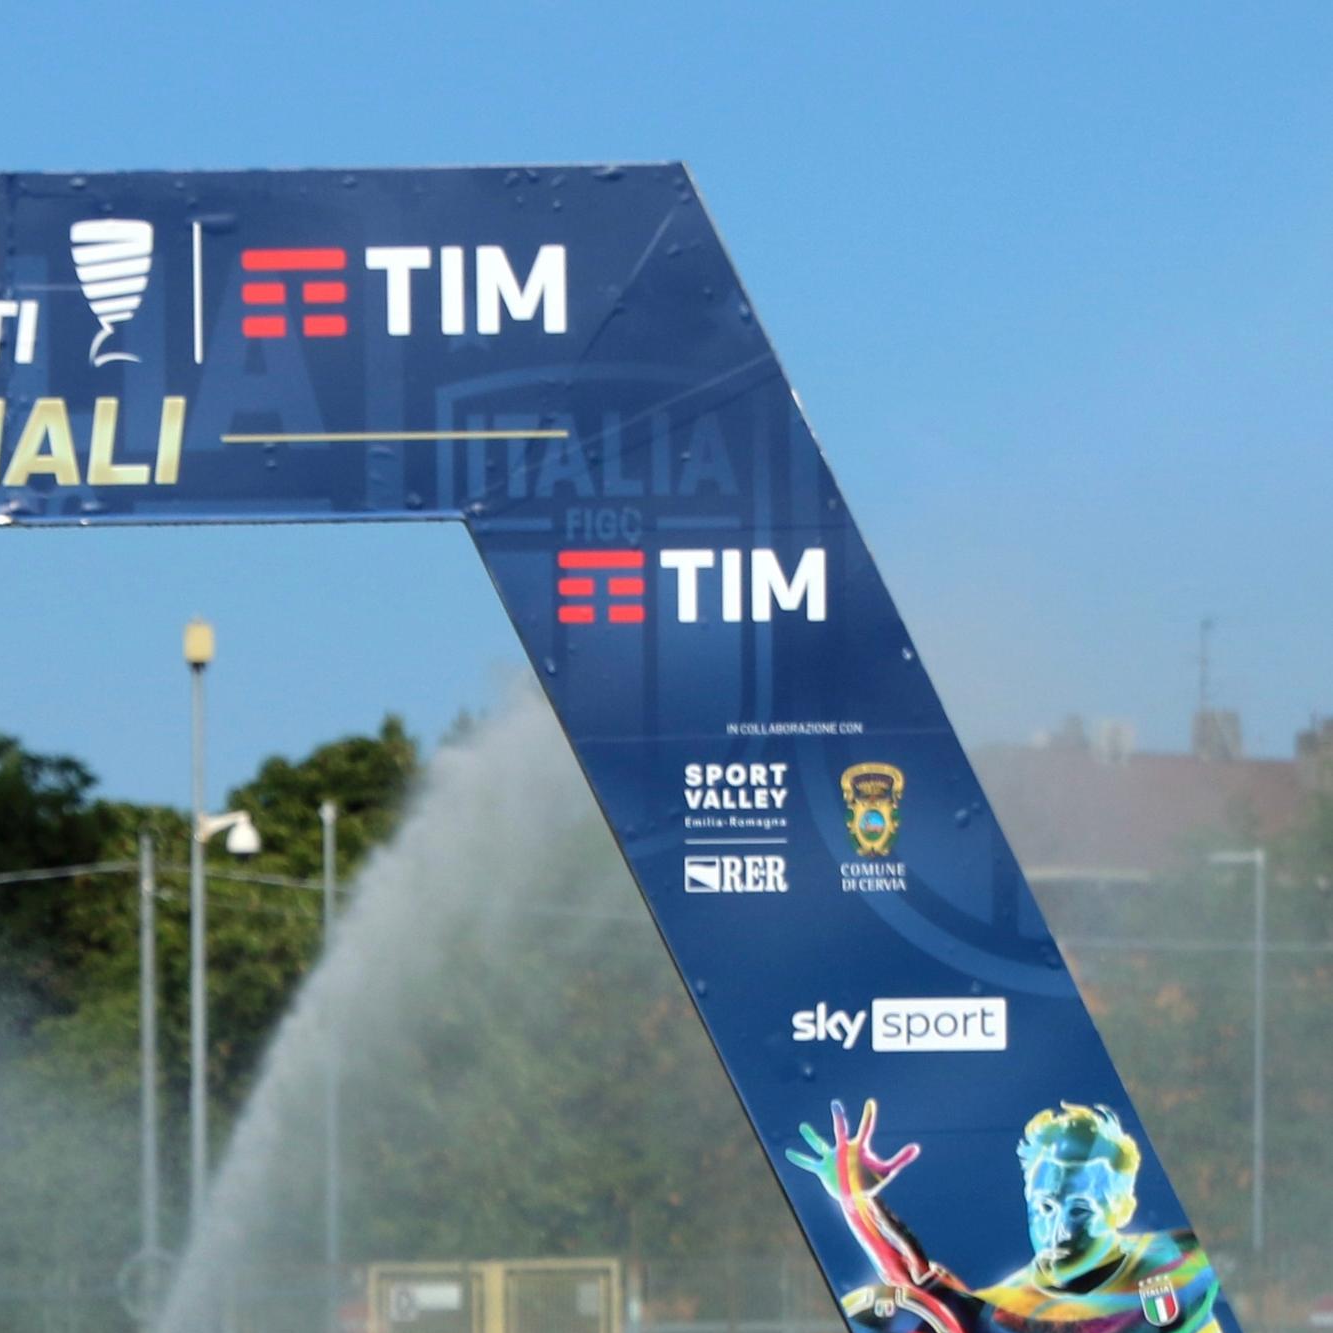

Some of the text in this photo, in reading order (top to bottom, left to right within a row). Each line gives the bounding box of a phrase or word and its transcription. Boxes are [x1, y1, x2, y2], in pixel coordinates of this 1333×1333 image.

[366, 244, 567, 336] TIM
[468, 412, 740, 497] ITALIA
[566, 506, 643, 542] FIGC
[659, 547, 827, 623] TIM
[727, 723, 739, 735] IN
[839, 721, 864, 734] CON
[685, 763, 787, 787] SPORT
[684, 788, 788, 810] VALLEY
[684, 815, 787, 830] Emilia-Romagna
[840, 862, 906, 878] COMUNE
[841, 878, 907, 892] DI CERVIA
[792, 1002, 996, 1050] sky sport
